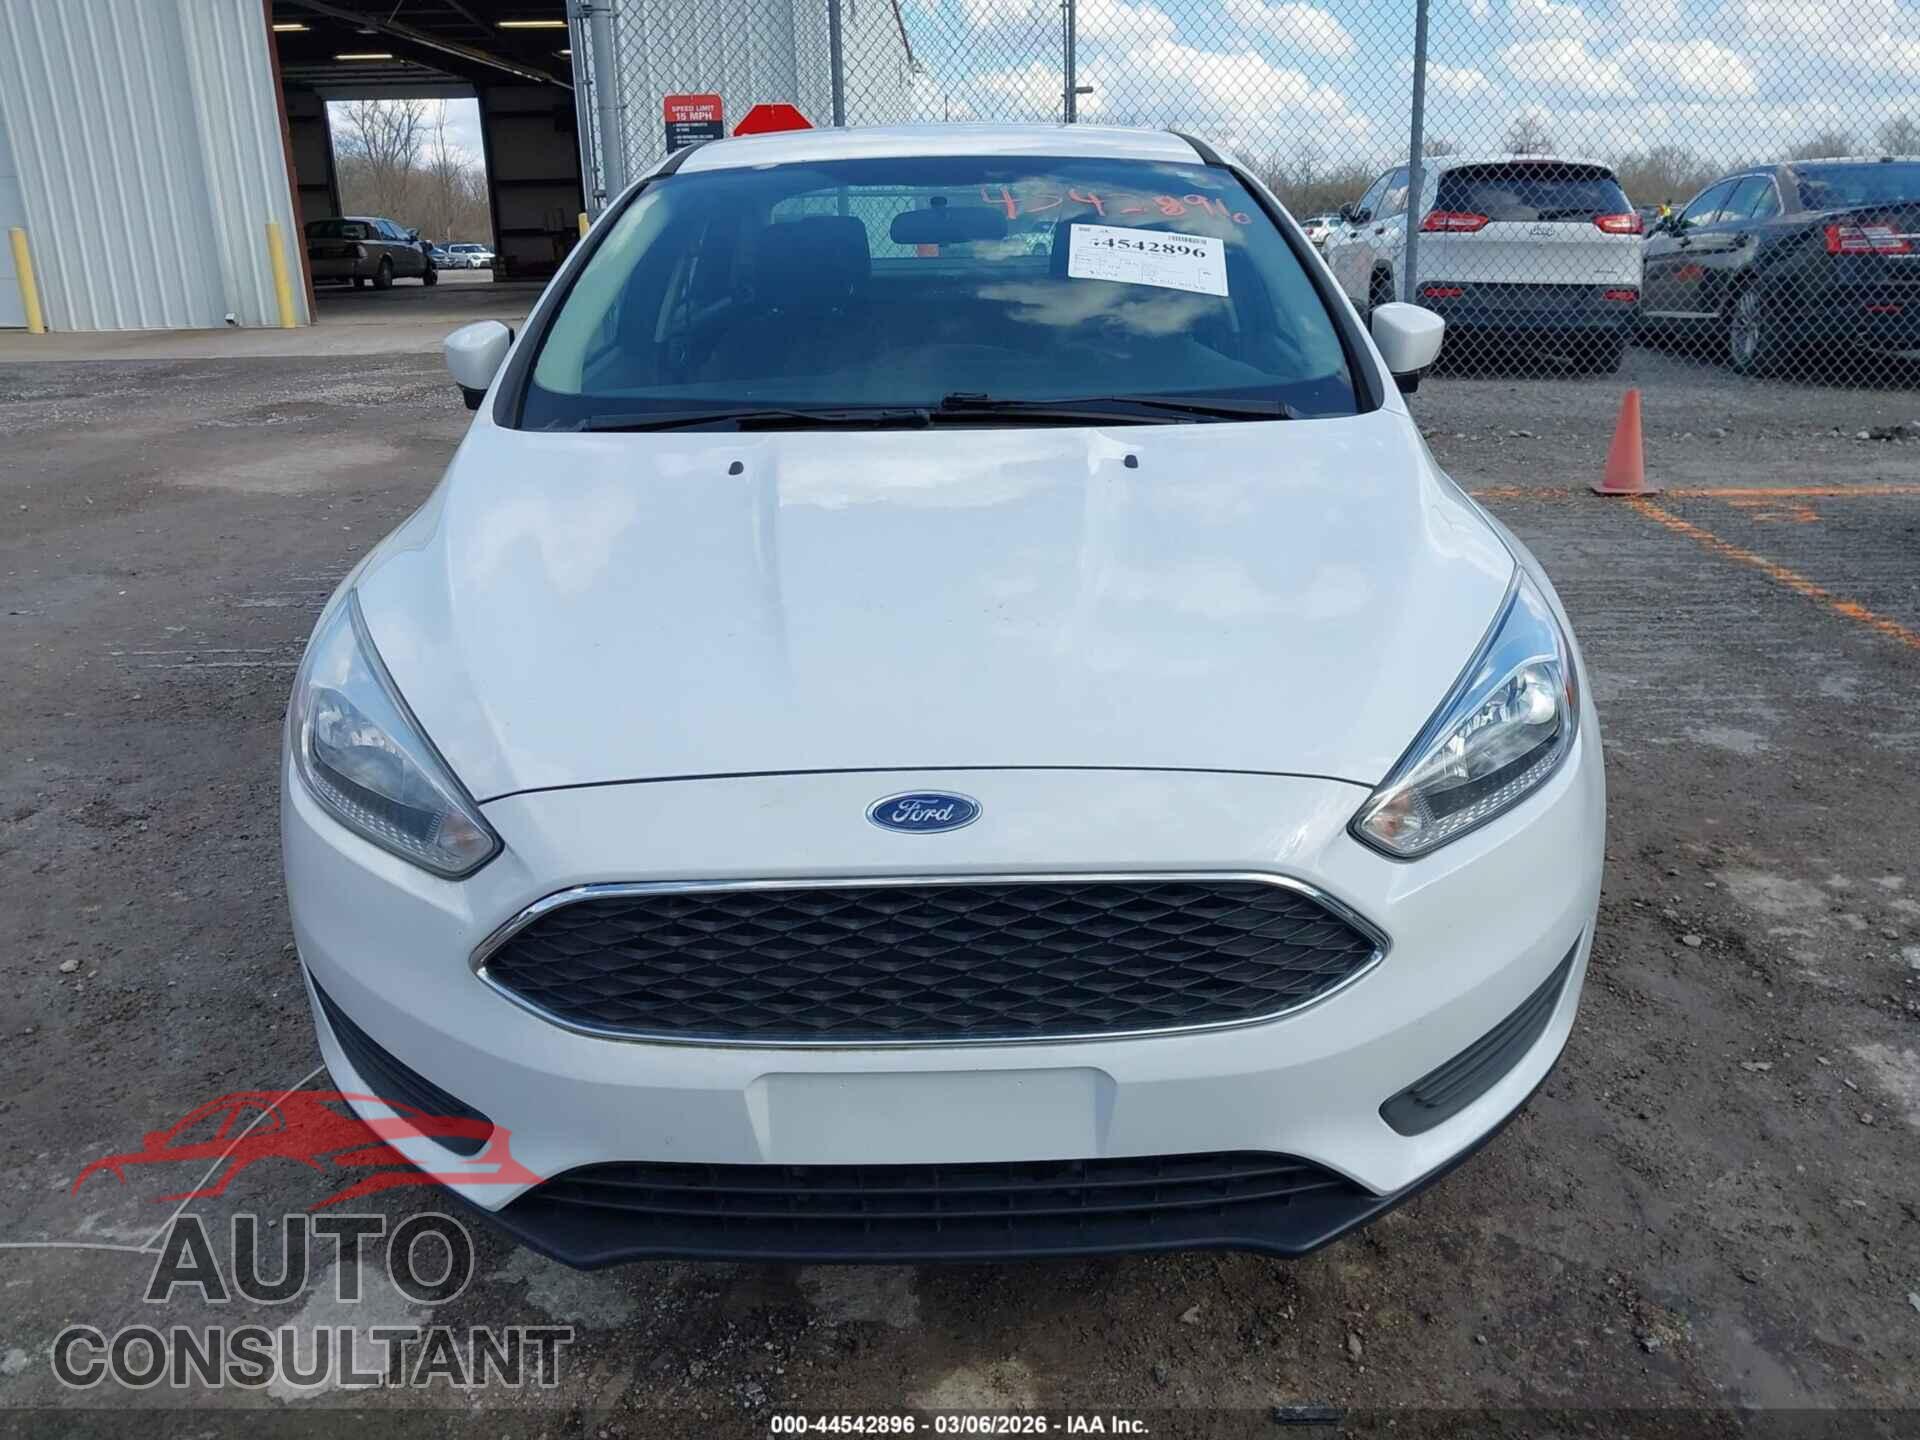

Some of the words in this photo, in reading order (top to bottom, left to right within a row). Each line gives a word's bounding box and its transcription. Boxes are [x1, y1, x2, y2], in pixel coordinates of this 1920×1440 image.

[671, 105, 694, 113] SPEED
[696, 104, 715, 112] LIMIT
[675, 112, 687, 121] 15
[689, 111, 713, 121] MPH
[891, 798, 955, 823] Ford
